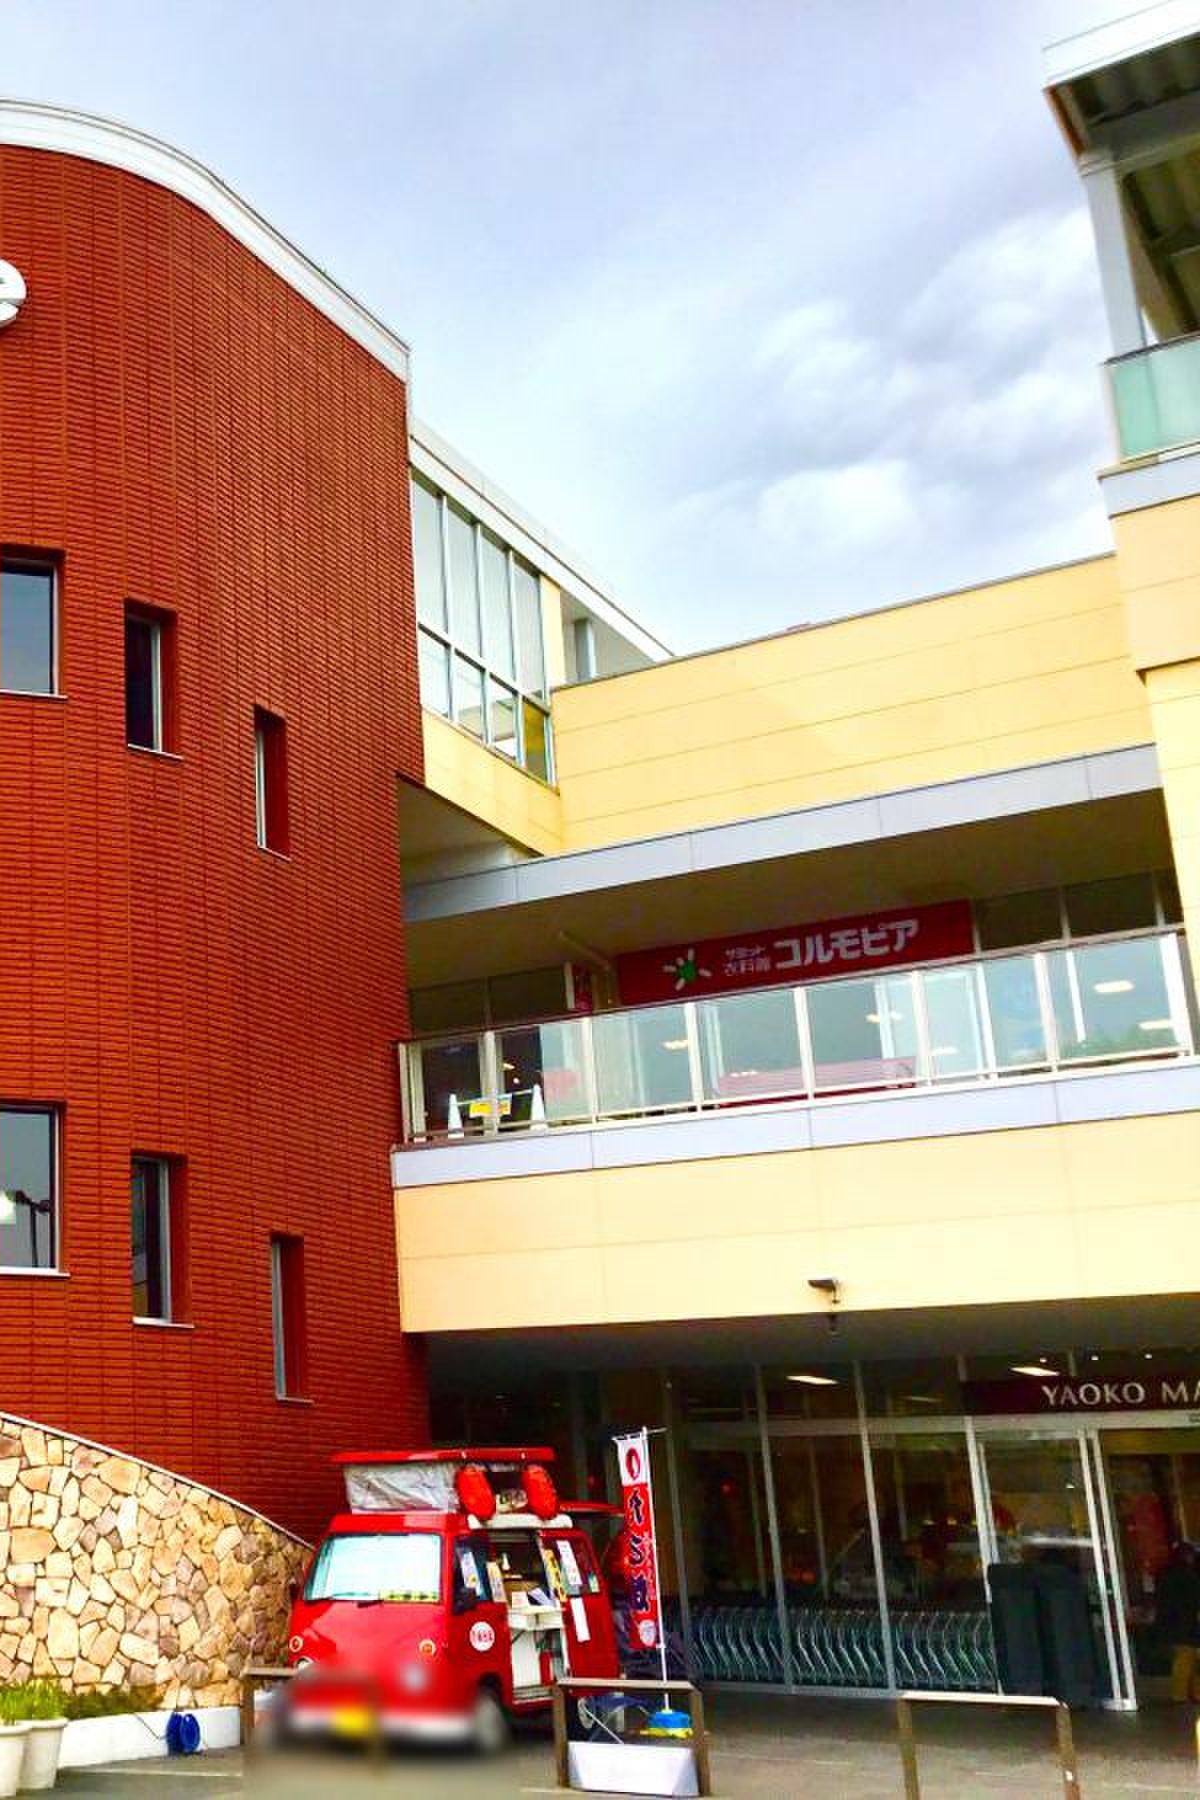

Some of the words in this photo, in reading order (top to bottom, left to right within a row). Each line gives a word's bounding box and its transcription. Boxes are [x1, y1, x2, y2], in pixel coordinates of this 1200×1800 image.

[773, 918, 920, 969] コルモピア
[1040, 1381, 1146, 1406] YAOKO
